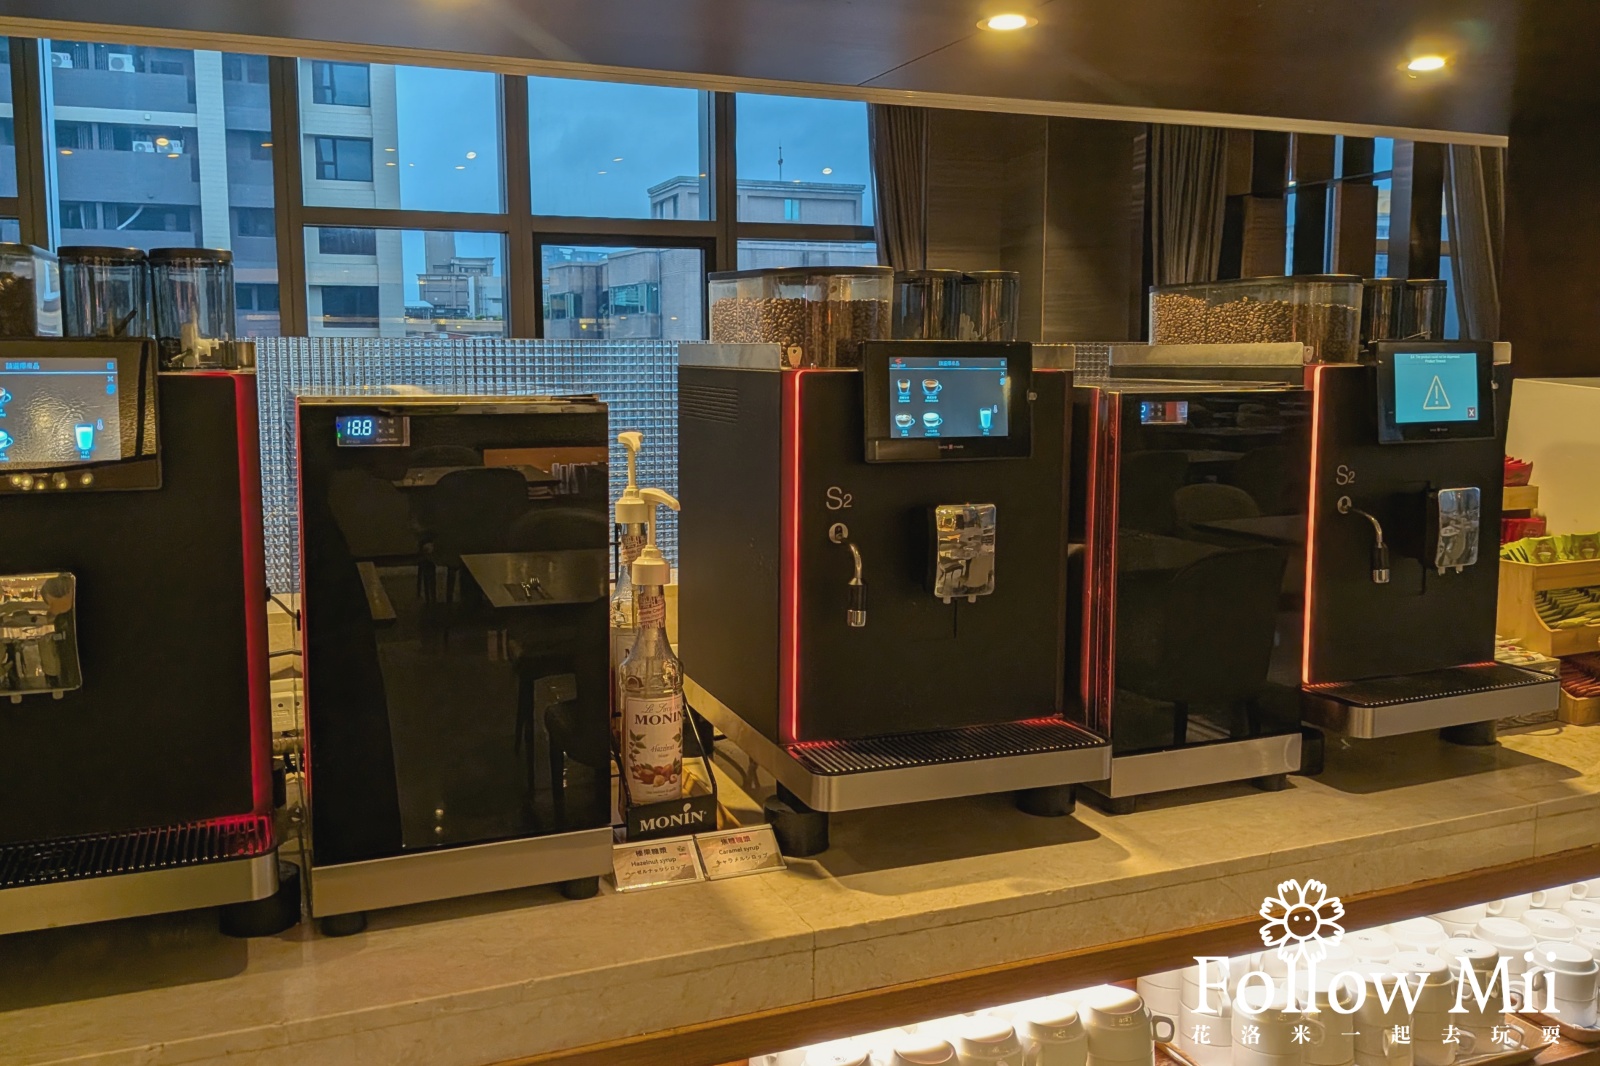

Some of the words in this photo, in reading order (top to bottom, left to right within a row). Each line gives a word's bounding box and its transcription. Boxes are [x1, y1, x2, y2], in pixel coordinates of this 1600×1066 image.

[347, 419, 372, 436] 18.8
[1336, 464, 1356, 486] S2
[826, 486, 853, 510] S2
[639, 804, 704, 832] MONIN
[718, 847, 743, 856] Caramel
[743, 844, 760, 854] syrup
[630, 858, 659, 868] Hazelnut
[659, 856, 677, 866] syrup
